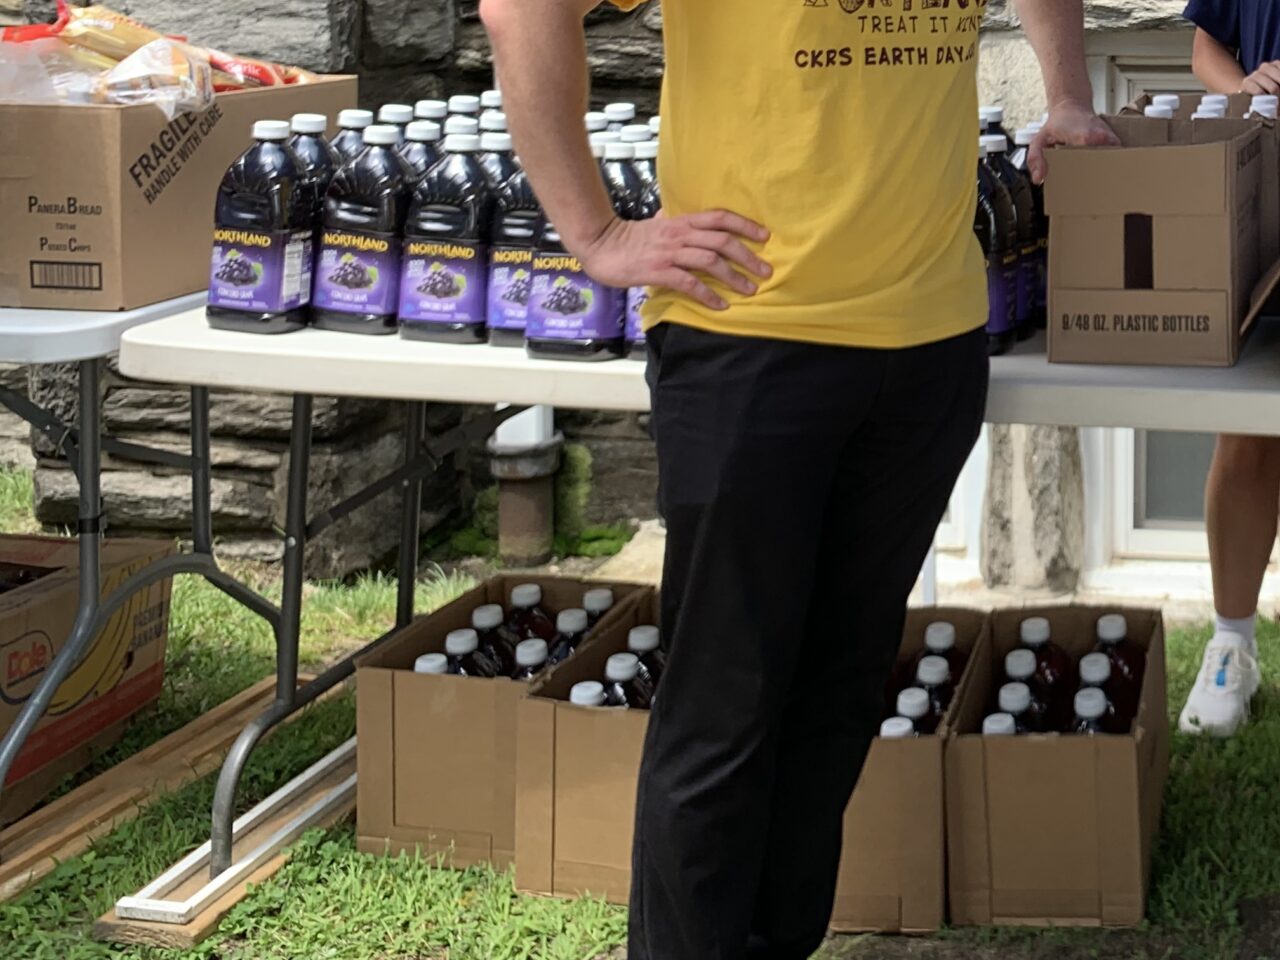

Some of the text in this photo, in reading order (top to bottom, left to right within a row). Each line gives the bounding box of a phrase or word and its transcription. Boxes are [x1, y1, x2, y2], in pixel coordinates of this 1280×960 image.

[858, 16, 918, 34] TREAT
[930, 16, 949, 33] IT
[794, 47, 853, 69] CKRS
[864, 46, 928, 66] EARTH
[129, 111, 198, 188] FRAGILE
[143, 103, 224, 205] HANDLE WITH CARE
[28, 195, 102, 215] PANERA BREAD
[323, 232, 389, 252] NORTHLAND
[408, 243, 475, 259] NORTHLAND
[1093, 313, 1110, 332] OZ.
[1113, 314, 1159, 332] PLASTIC
[1162, 314, 1210, 332] BOTTLES
[7, 641, 47, 680] Dole
